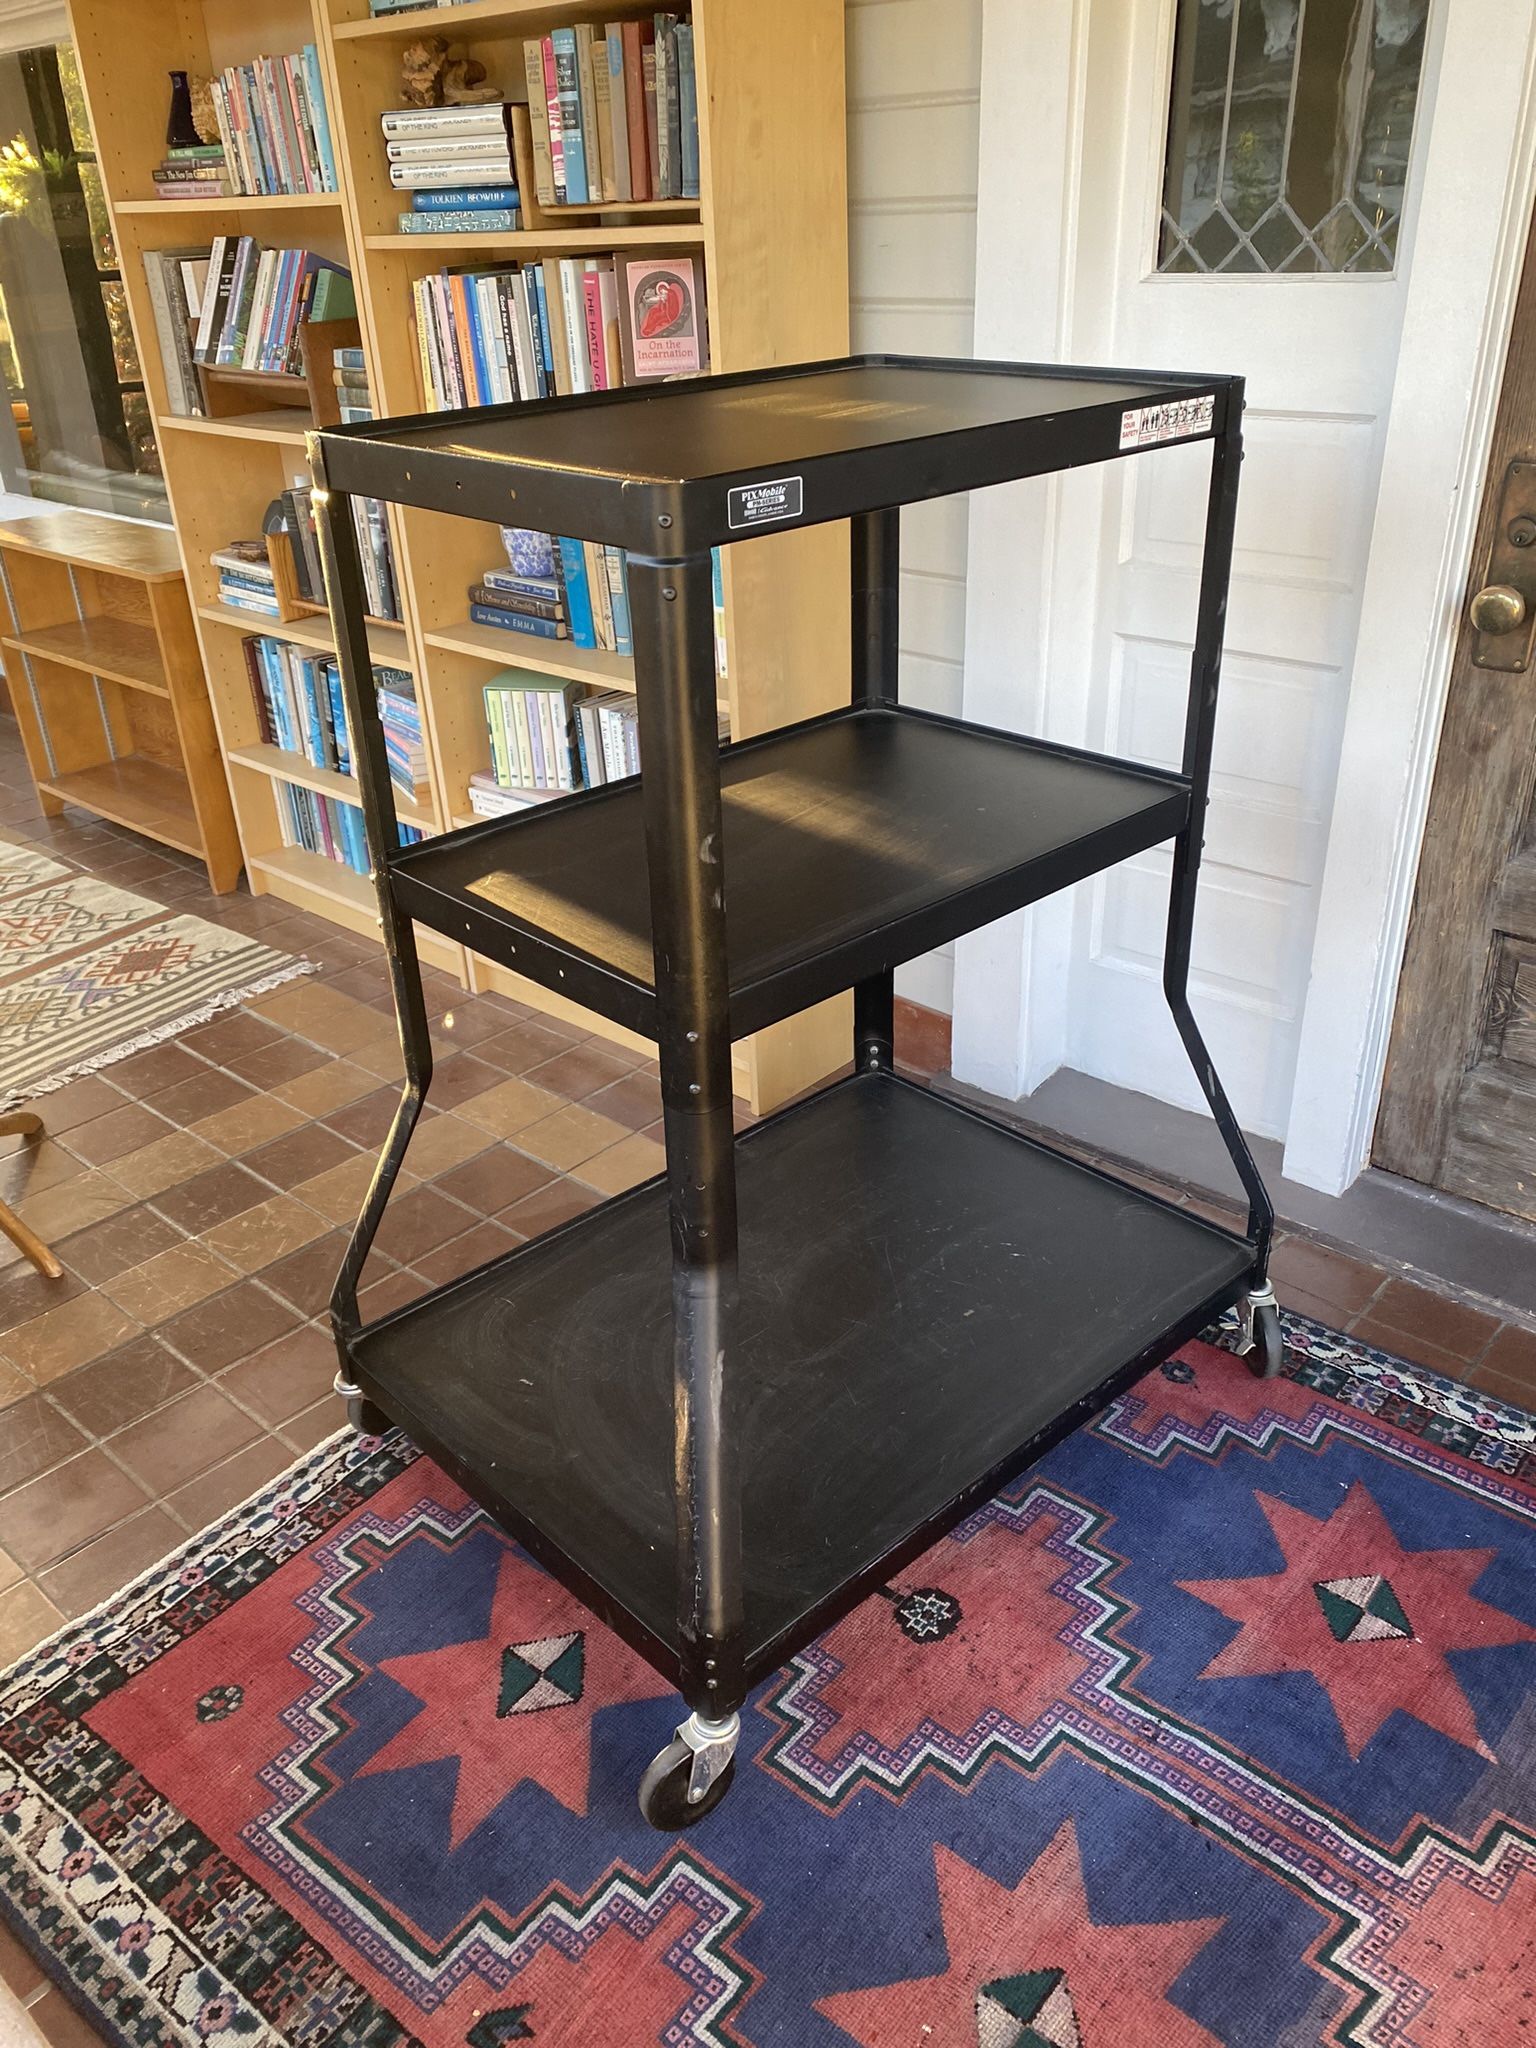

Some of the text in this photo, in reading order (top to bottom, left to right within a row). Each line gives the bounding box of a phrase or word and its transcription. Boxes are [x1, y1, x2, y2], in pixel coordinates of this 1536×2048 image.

[298, 94, 309, 130] FREEDOM
[431, 192, 504, 204] TOLKIEN BEOWULF
[585, 291, 596, 317] THE
[531, 313, 539, 337] Walking
[504, 334, 512, 356] name
[589, 321, 598, 358] HATE
[649, 340, 681, 350] On the
[638, 349, 694, 360] Incarnation
[592, 360, 599, 368] U
[1122, 430, 1138, 438] SAFETY
[742, 486, 786, 502] PIXMobile
[486, 615, 502, 624] Austen
[512, 618, 535, 631] EMMA
